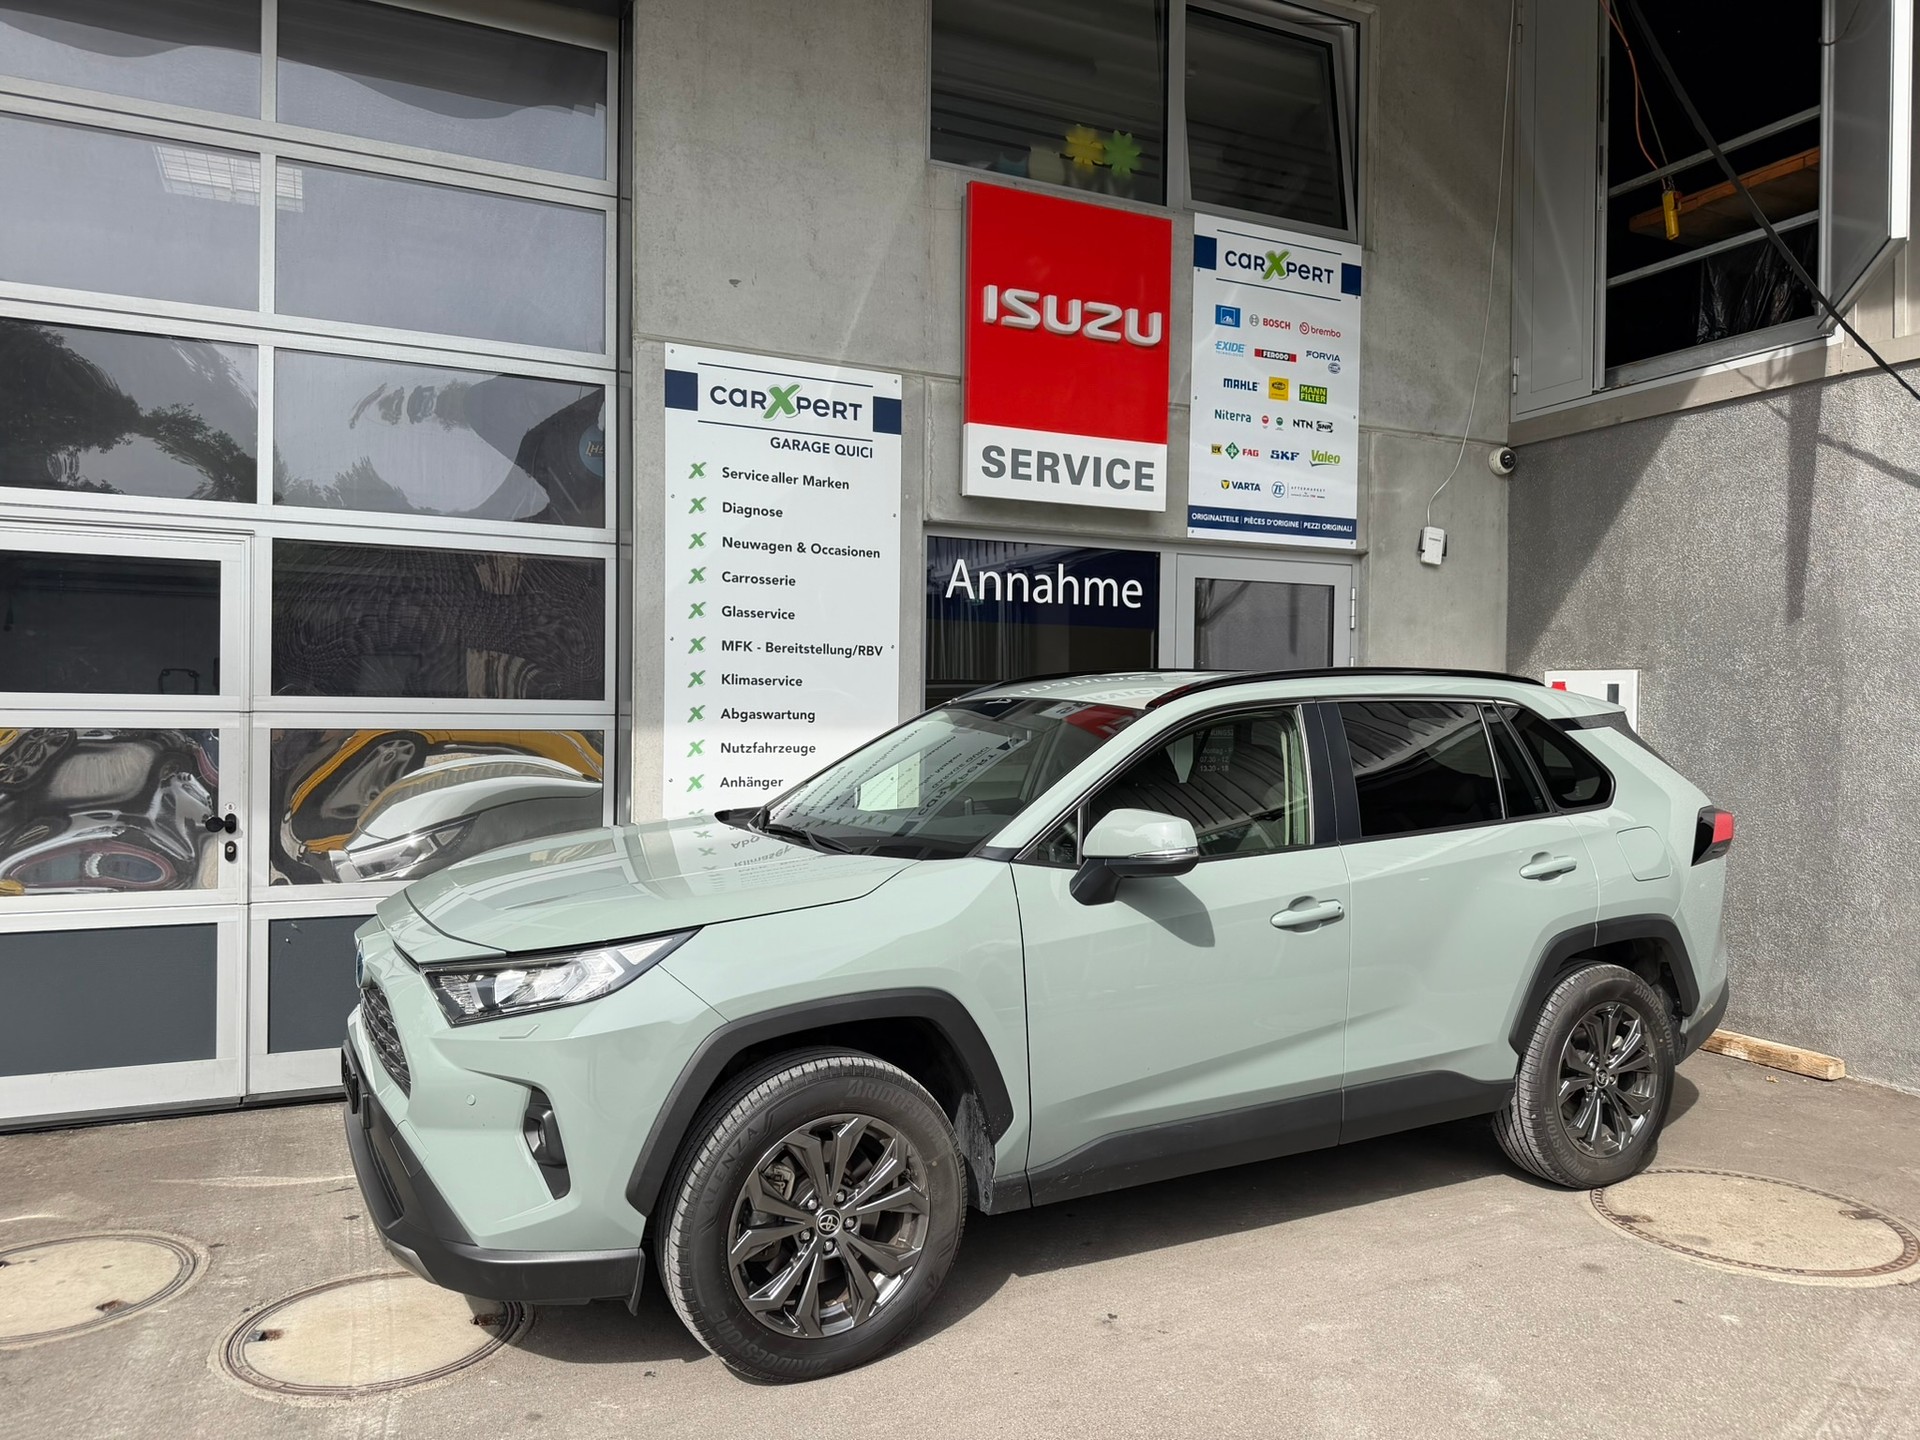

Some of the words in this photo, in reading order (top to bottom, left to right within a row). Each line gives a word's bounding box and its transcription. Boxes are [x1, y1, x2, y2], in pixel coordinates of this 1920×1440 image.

[982, 284, 1162, 347] ISUZU
[1262, 317, 1291, 331] BOSCH
[1310, 326, 1341, 338] brembo
[1215, 340, 1245, 353] EXIDE
[1262, 350, 1289, 361] FERODO
[1306, 350, 1341, 362] FORVIA
[1223, 378, 1258, 392] MAHLE
[1300, 386, 1326, 396] MANN
[1300, 393, 1326, 403] FILTER
[1214, 409, 1252, 423] Niterra
[1292, 419, 1313, 429] NTN
[770, 436, 830, 455] GARAGE
[834, 444, 873, 459] QUICI
[1242, 448, 1259, 457] FAG
[1270, 450, 1300, 461] SKF
[1311, 449, 1341, 465] Valeo
[981, 444, 1155, 492] SERVICE
[722, 467, 769, 483] Service
[771, 471, 799, 485] aller
[802, 474, 850, 490] Marken
[1231, 481, 1261, 492] VARTA
[1273, 484, 1284, 495] ZF
[721, 501, 783, 518] Diagnose
[1191, 512, 1239, 524] ORIGINALTEILE
[1243, 515, 1266, 526] PIÈCES
[1266, 518, 1300, 528] D'ORIGINE
[1303, 521, 1320, 530] PEZZI
[1321, 522, 1353, 532] ORIGINALI
[721, 536, 793, 554] Neuwagen
[797, 542, 807, 554] &
[810, 543, 880, 559] Occasionen
[721, 571, 796, 587] Carrosserie
[945, 558, 1144, 609] Annahme
[721, 605, 796, 620] Glasservice
[721, 640, 753, 652] MFK
[765, 641, 883, 659] Bereitstellung/RBV
[721, 673, 803, 687] Klimaservice
[720, 708, 816, 723] Abgaswartung
[720, 741, 816, 757] Nutzfahrzeuge
[720, 775, 783, 792] Anhänger
[702, 1126, 759, 1210] ALENZA
